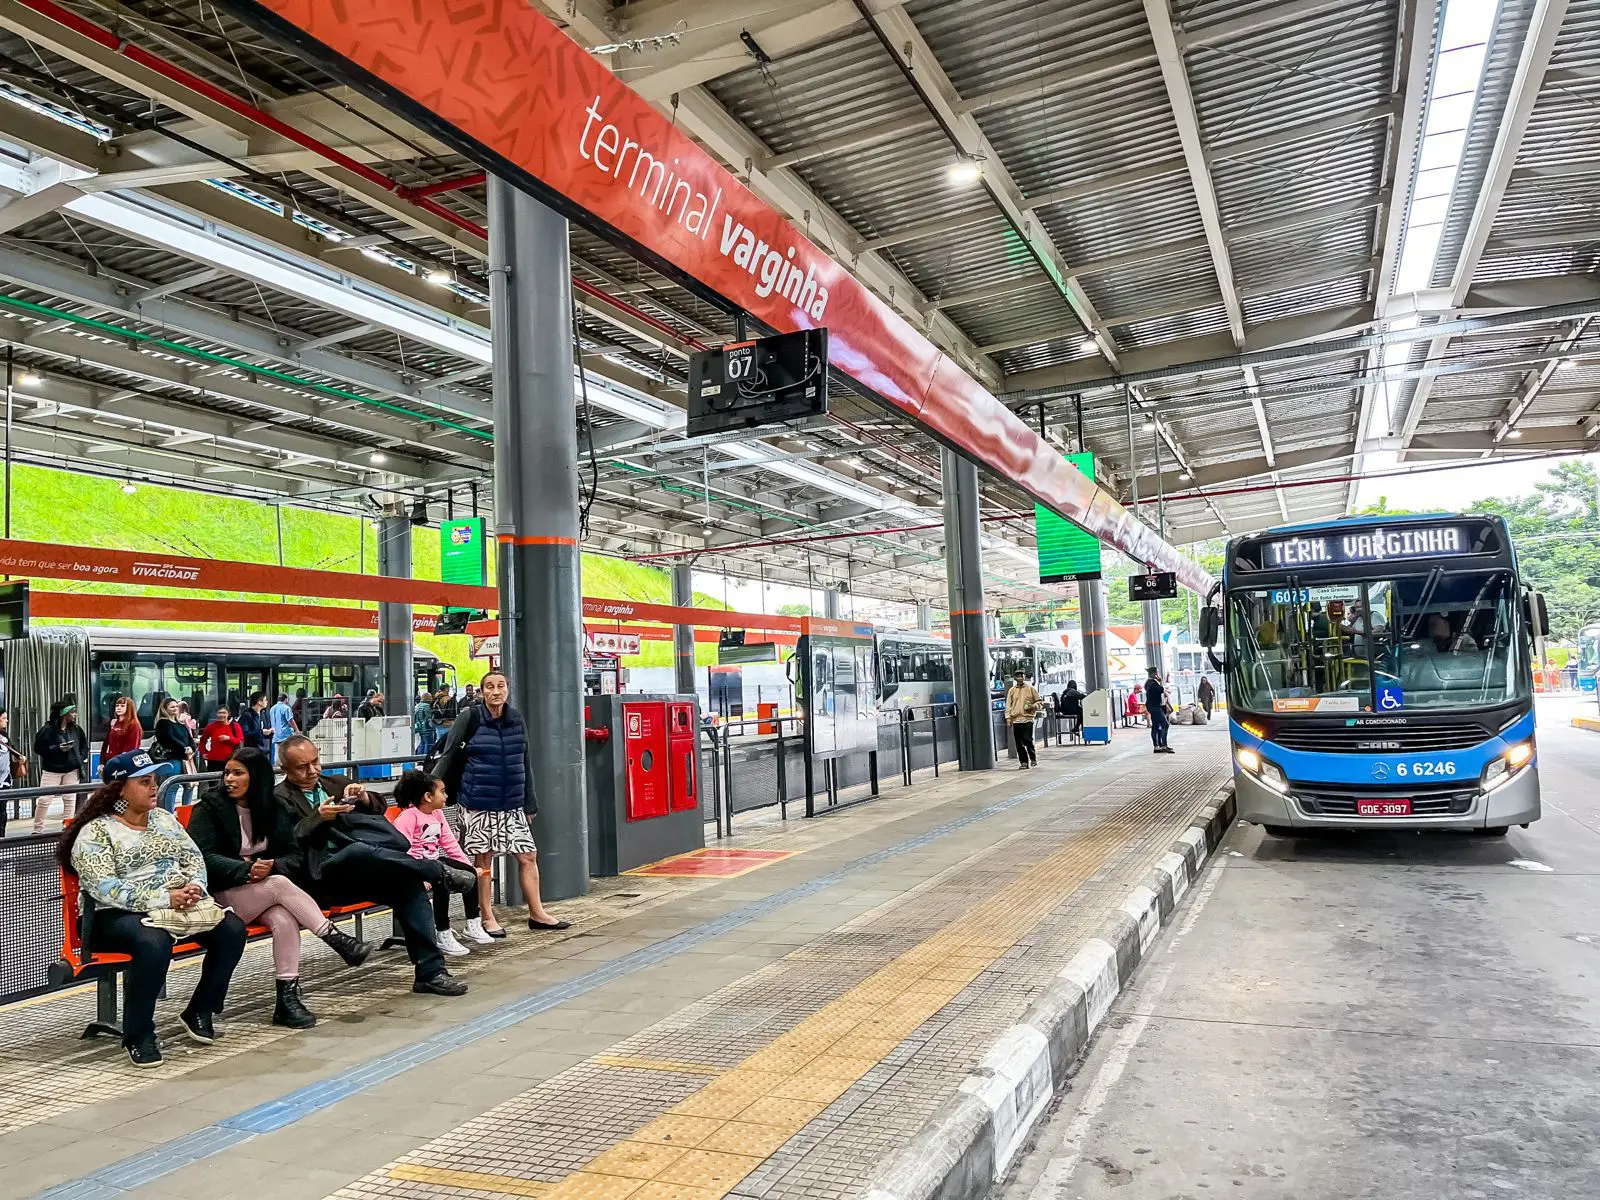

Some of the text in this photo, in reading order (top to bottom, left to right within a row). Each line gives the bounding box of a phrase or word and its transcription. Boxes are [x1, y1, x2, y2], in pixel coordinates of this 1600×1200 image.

[579, 95, 829, 322] terminal varginha
[729, 347, 751, 359] ponto
[728, 356, 753, 379] 07
[1272, 528, 1459, 564] TERM. VARGINHA
[18, 557, 37, 568] tem
[38, 560, 56, 572] que
[58, 562, 72, 571] ser
[73, 561, 91, 573] boa
[132, 566, 199, 581] VIVACIDADE
[1146, 580, 1157, 588] 06
[583, 602, 634, 616] rminal varginha
[412, 617, 438, 629] rginha
[1396, 761, 1456, 776] 6 6246
